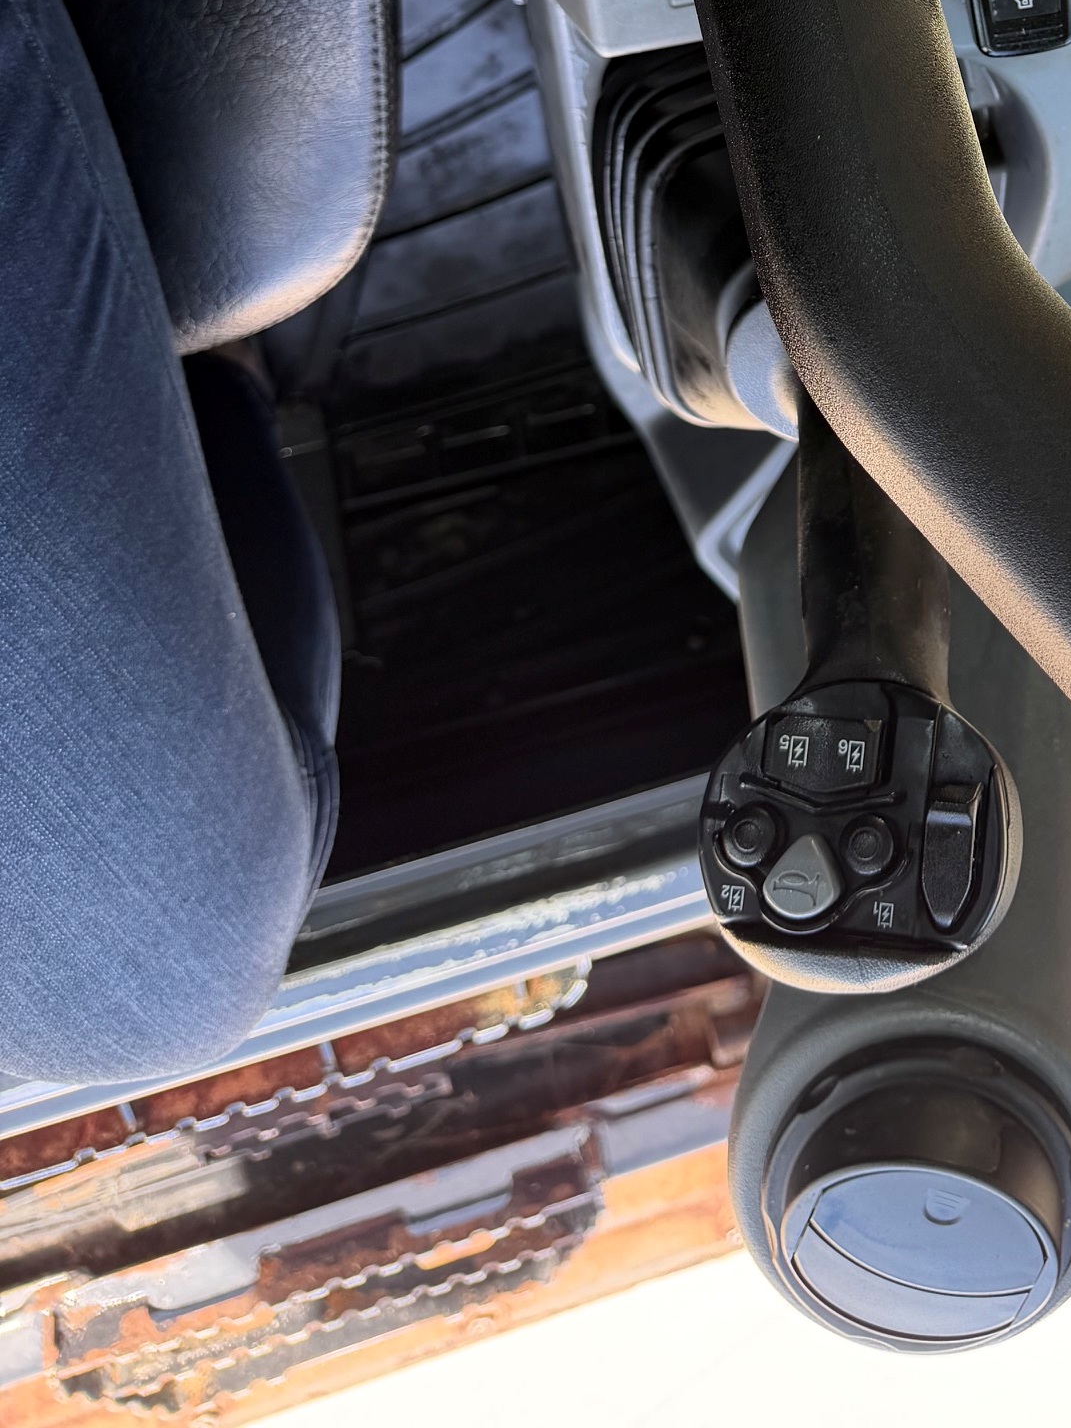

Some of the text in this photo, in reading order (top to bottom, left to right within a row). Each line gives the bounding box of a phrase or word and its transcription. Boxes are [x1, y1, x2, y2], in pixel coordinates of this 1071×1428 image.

[779, 734, 790, 750] 5
[838, 739, 849, 755] 6
[720, 884, 730, 898] 2
